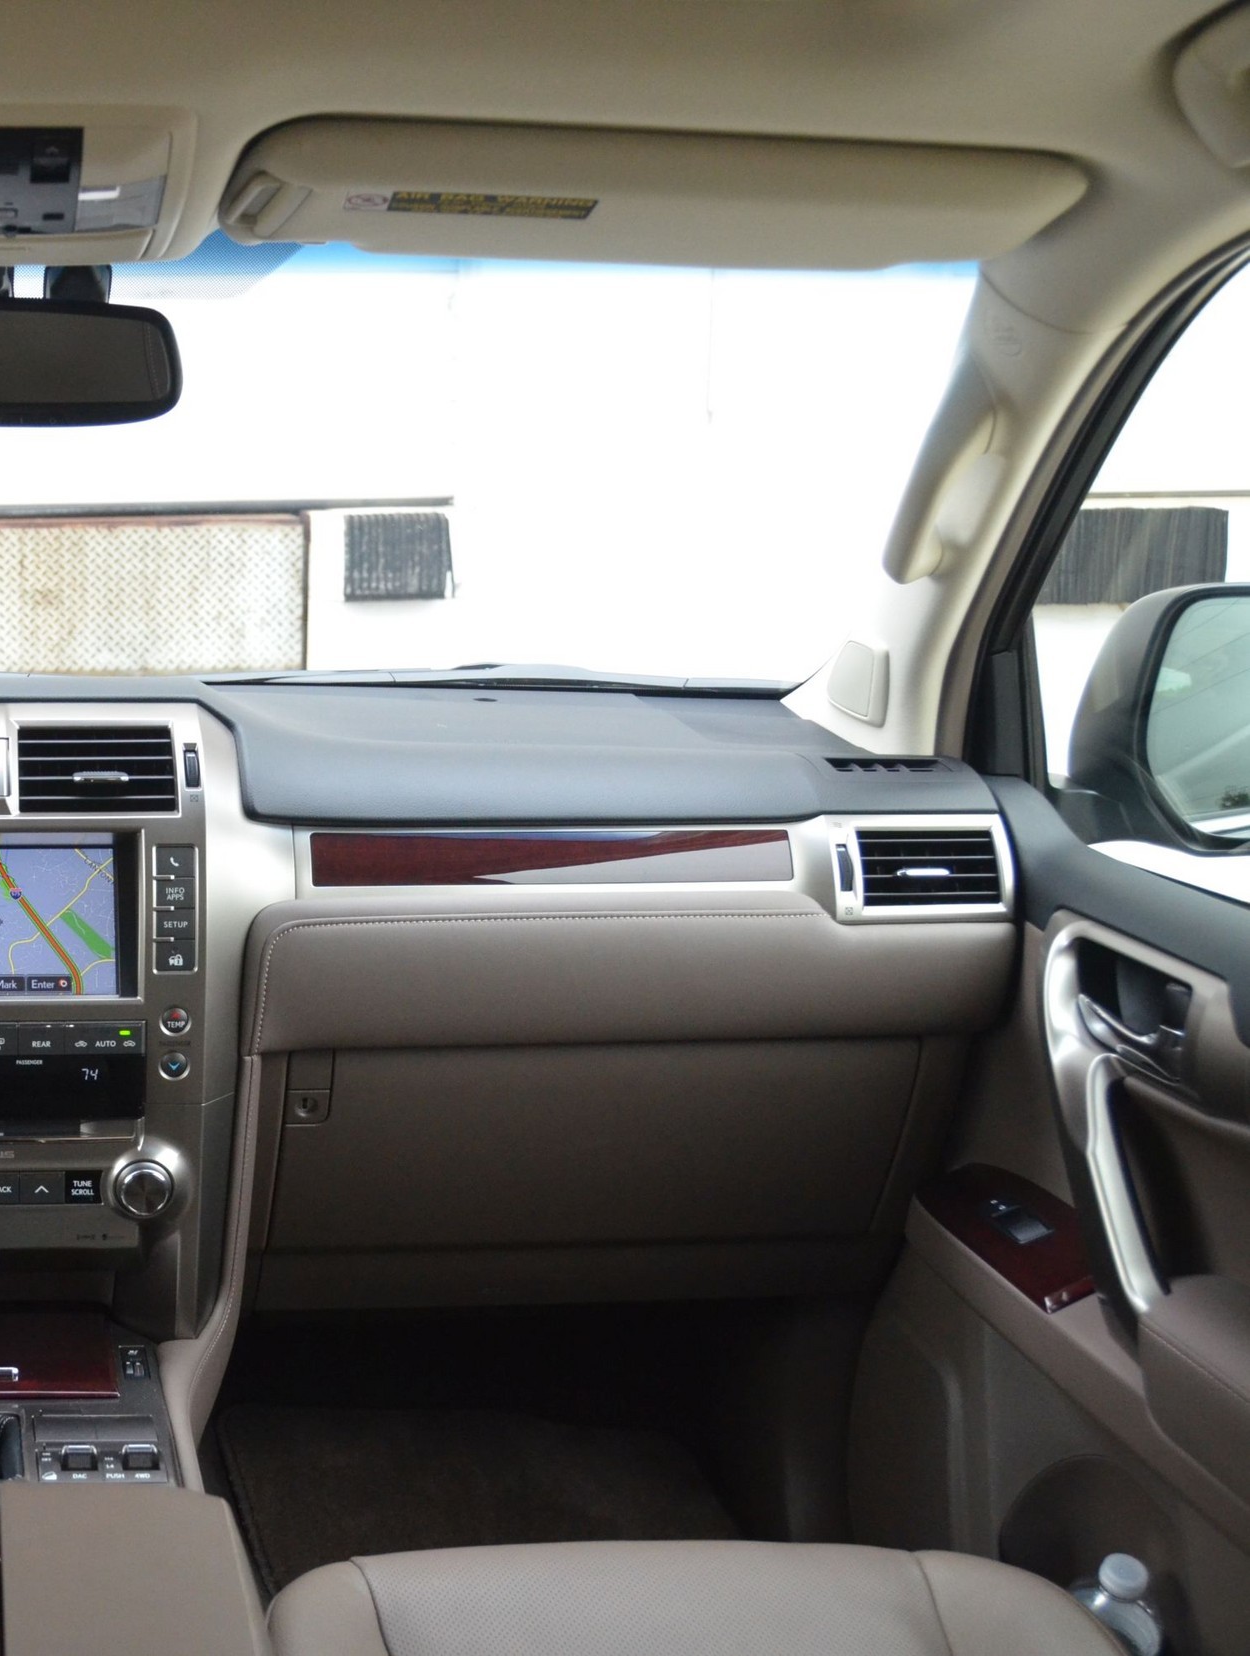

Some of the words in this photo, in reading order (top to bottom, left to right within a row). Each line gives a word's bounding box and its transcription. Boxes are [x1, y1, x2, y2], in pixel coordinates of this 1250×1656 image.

[31, 980, 55, 990] Enter
[167, 1020, 186, 1028] TEMP
[31, 1040, 51, 1048] REAR
[95, 1040, 117, 1048] AUTO
[81, 1068, 99, 1081] 74
[73, 1180, 92, 1188] TUNE
[71, 1188, 94, 1196] SCROLL
